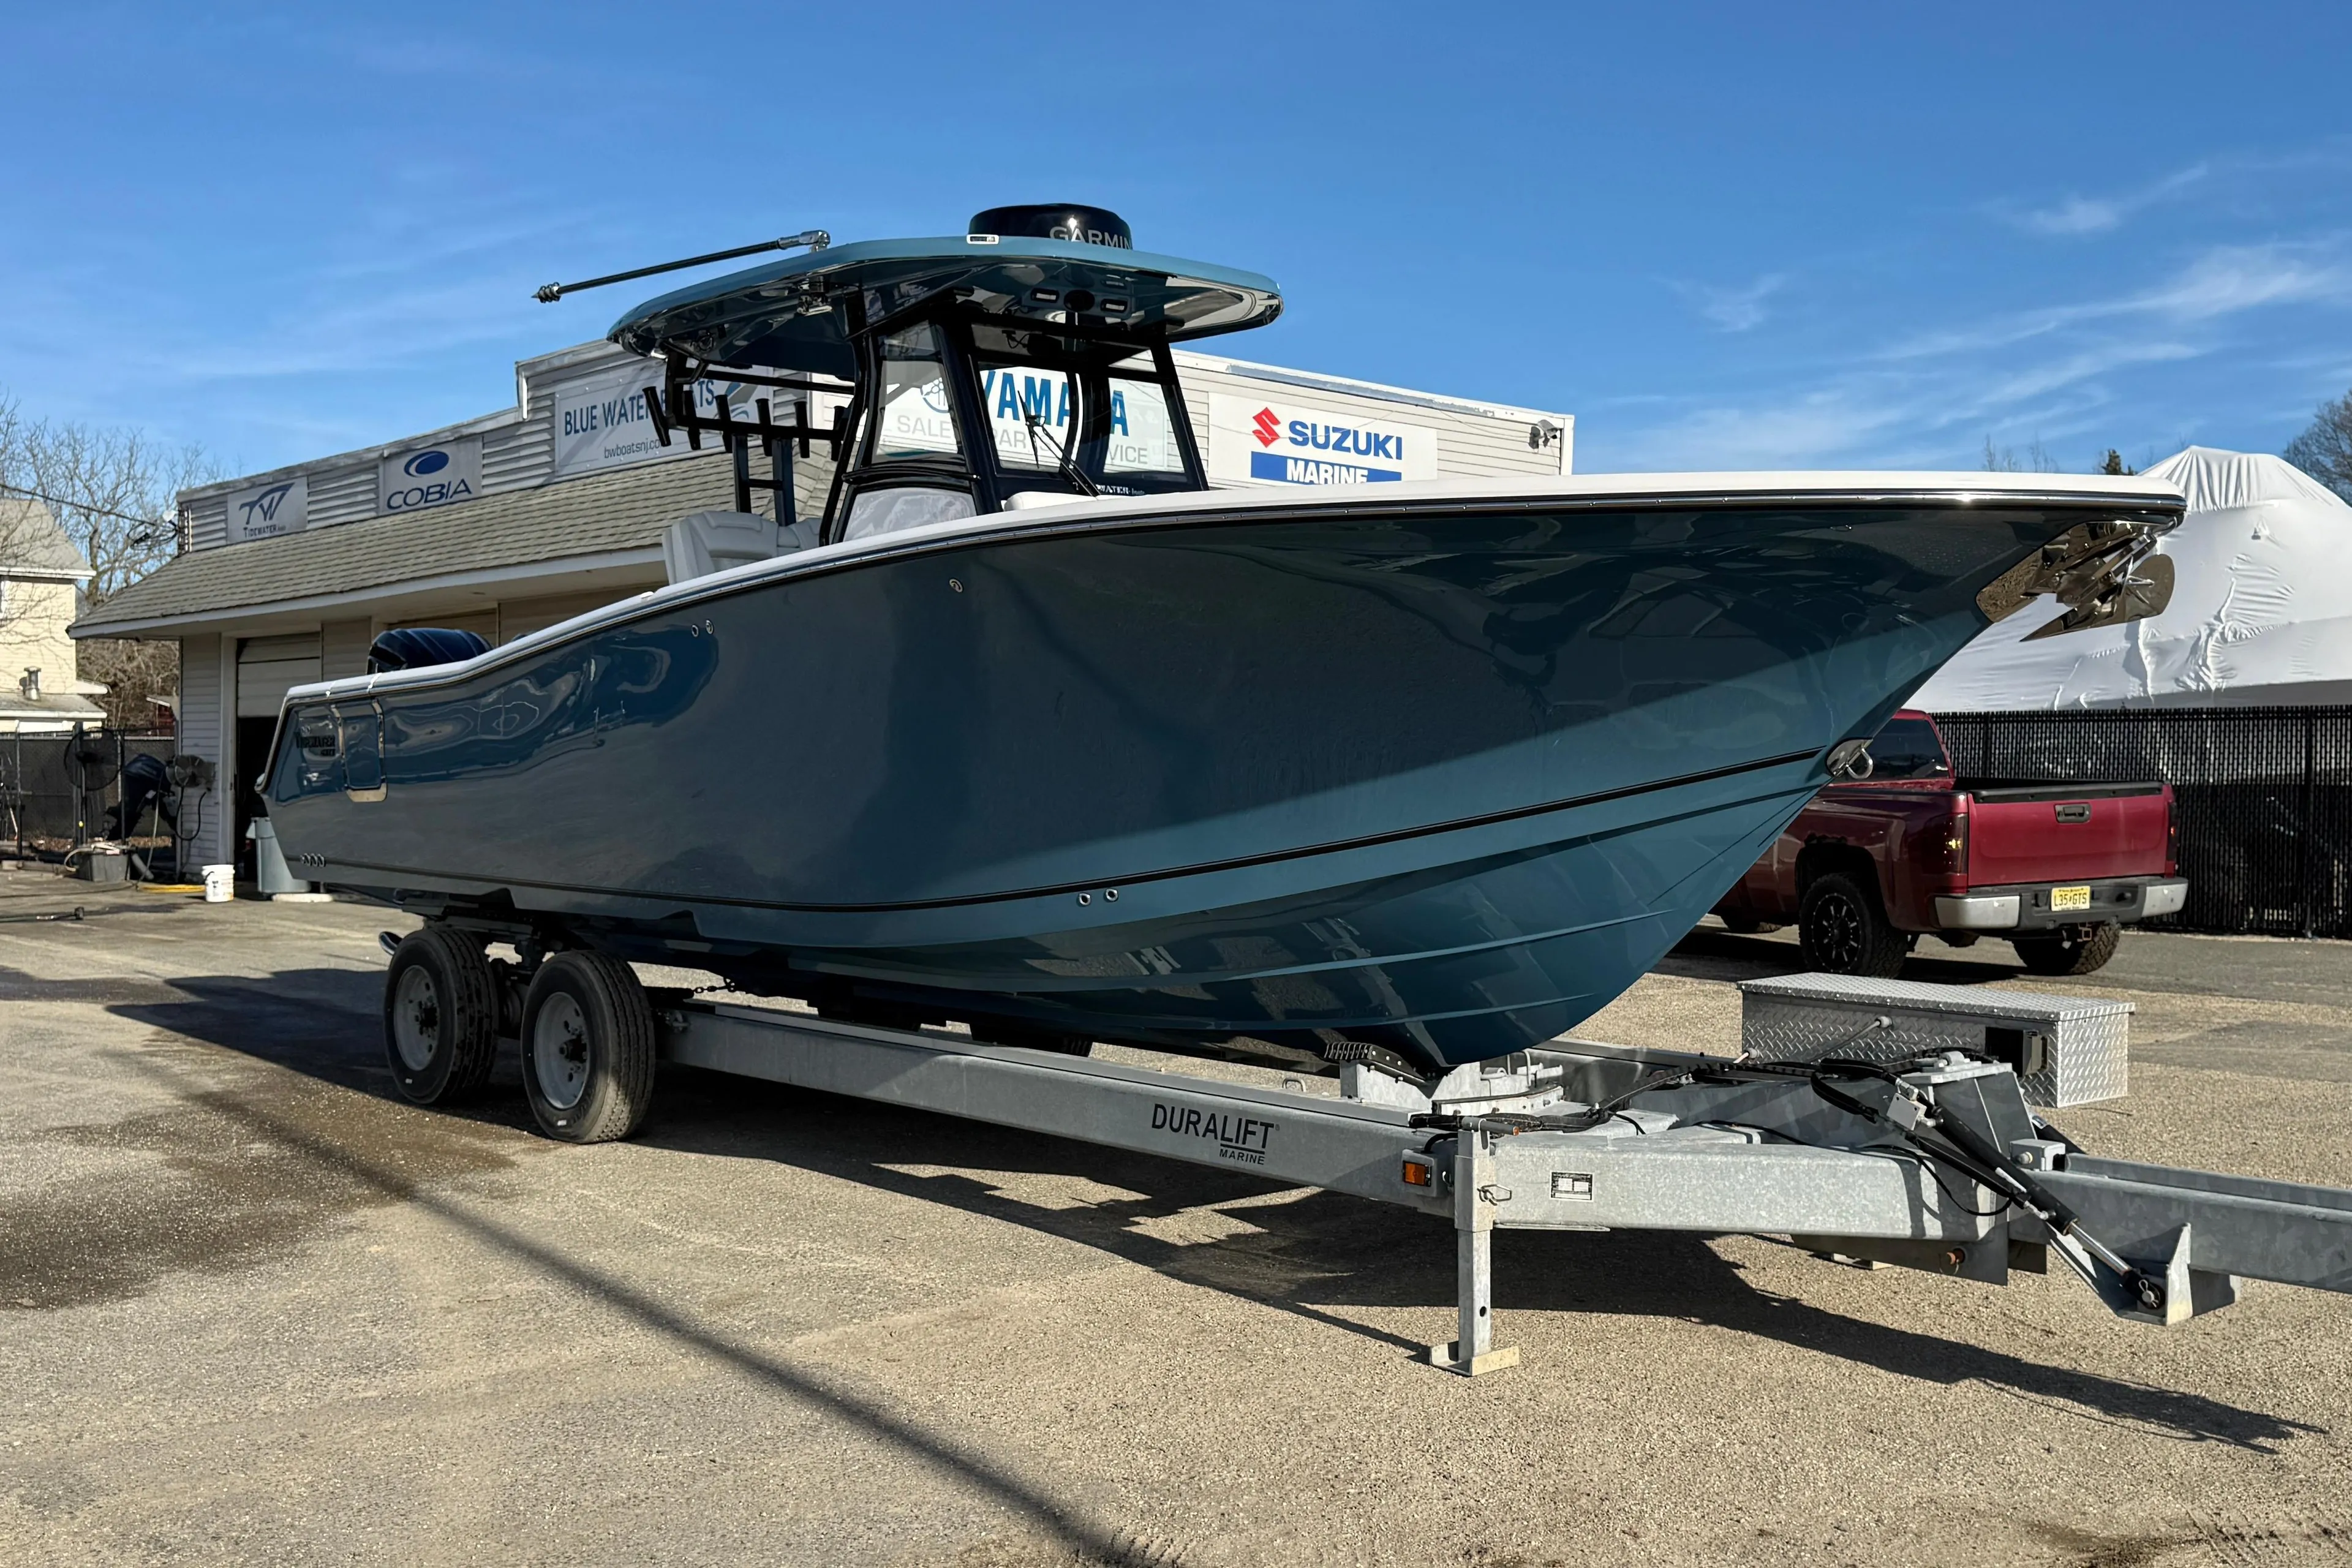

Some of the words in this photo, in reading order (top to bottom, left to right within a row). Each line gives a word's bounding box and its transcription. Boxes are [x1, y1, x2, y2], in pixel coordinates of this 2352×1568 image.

[1049, 226, 1133, 250] GARMIN
[564, 404, 597, 436] BLUE
[602, 394, 649, 428] WATE
[984, 369, 1129, 437] AMAA
[604, 437, 662, 459] bwboatsnj.co
[897, 415, 952, 439] SALE
[1109, 444, 1148, 464] VICE
[1288, 420, 1403, 461] SUZUKI
[1287, 458, 1369, 485] MARINE
[386, 478, 473, 510] COBIA
[1152, 1103, 1275, 1149] DURALIFT
[1219, 1148, 1265, 1165] MARINE
